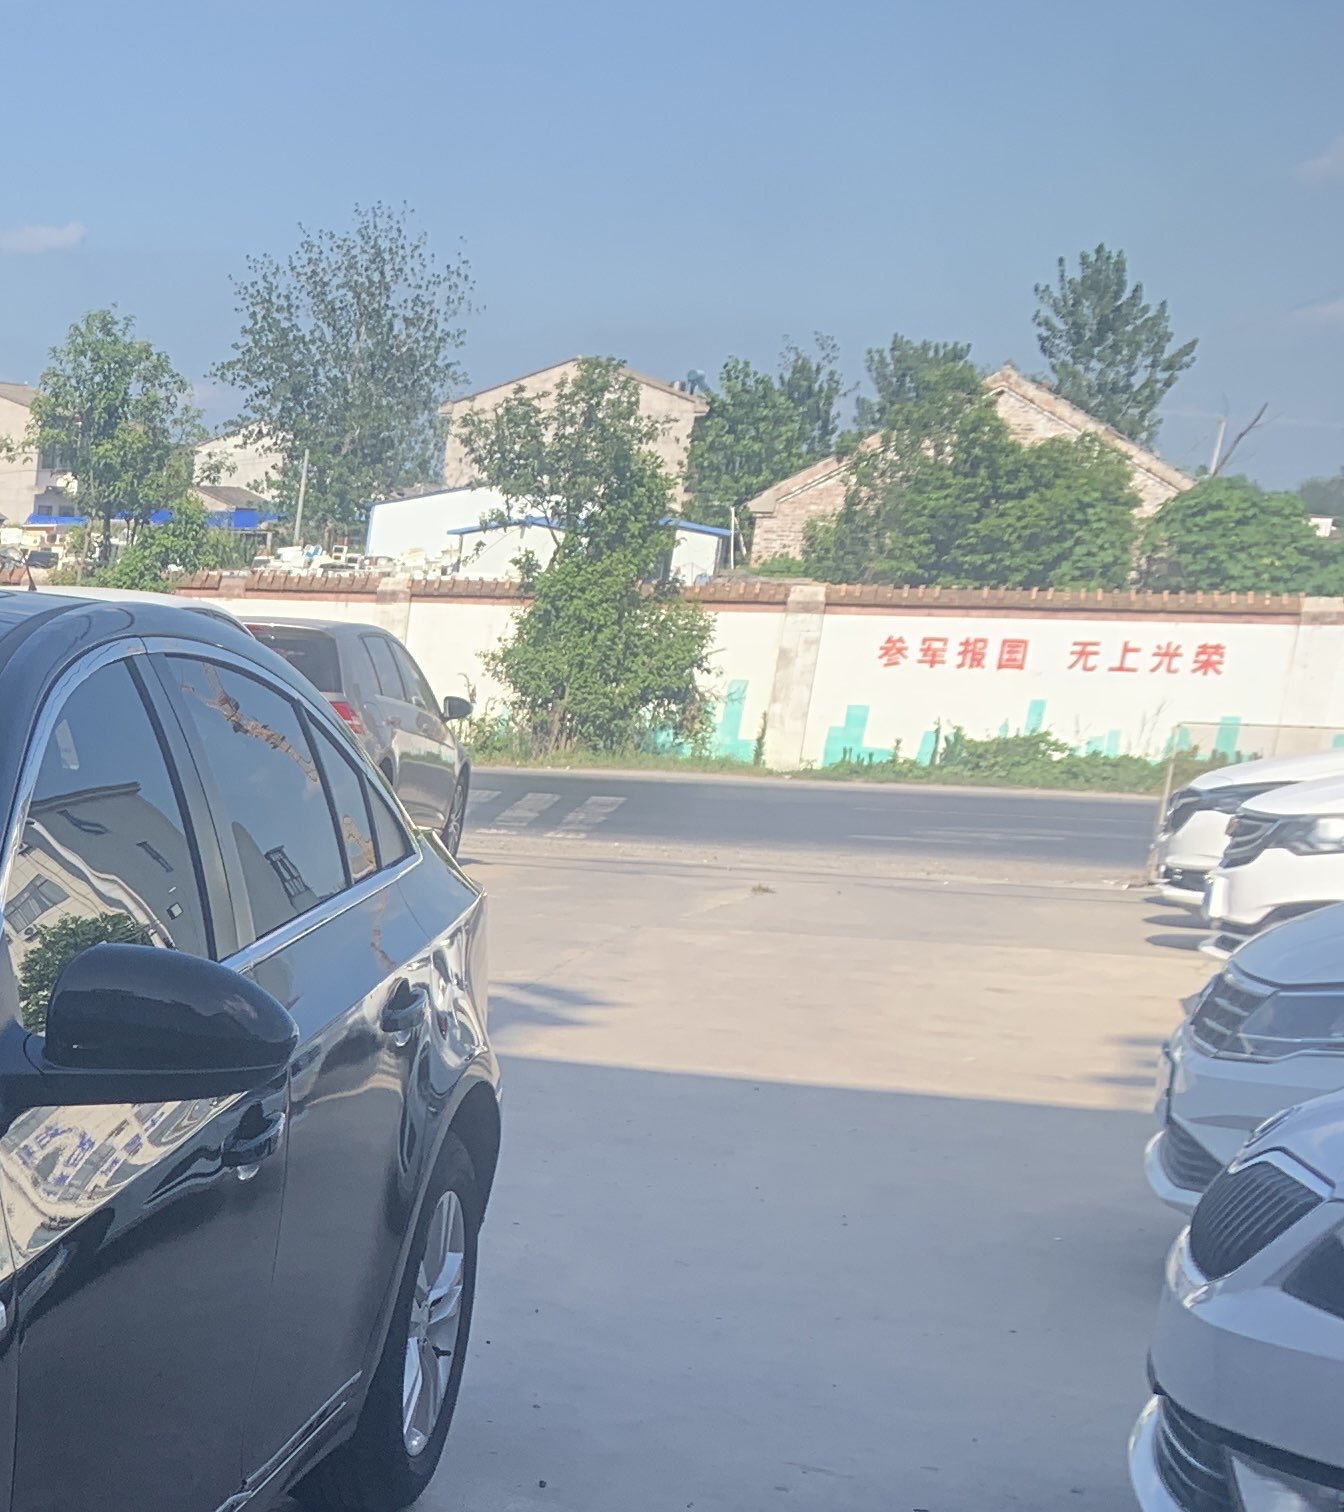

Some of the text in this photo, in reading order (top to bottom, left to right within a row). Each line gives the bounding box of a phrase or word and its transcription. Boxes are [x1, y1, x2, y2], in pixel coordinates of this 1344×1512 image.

[878, 635, 1228, 677] 参军报国 无上光荣
